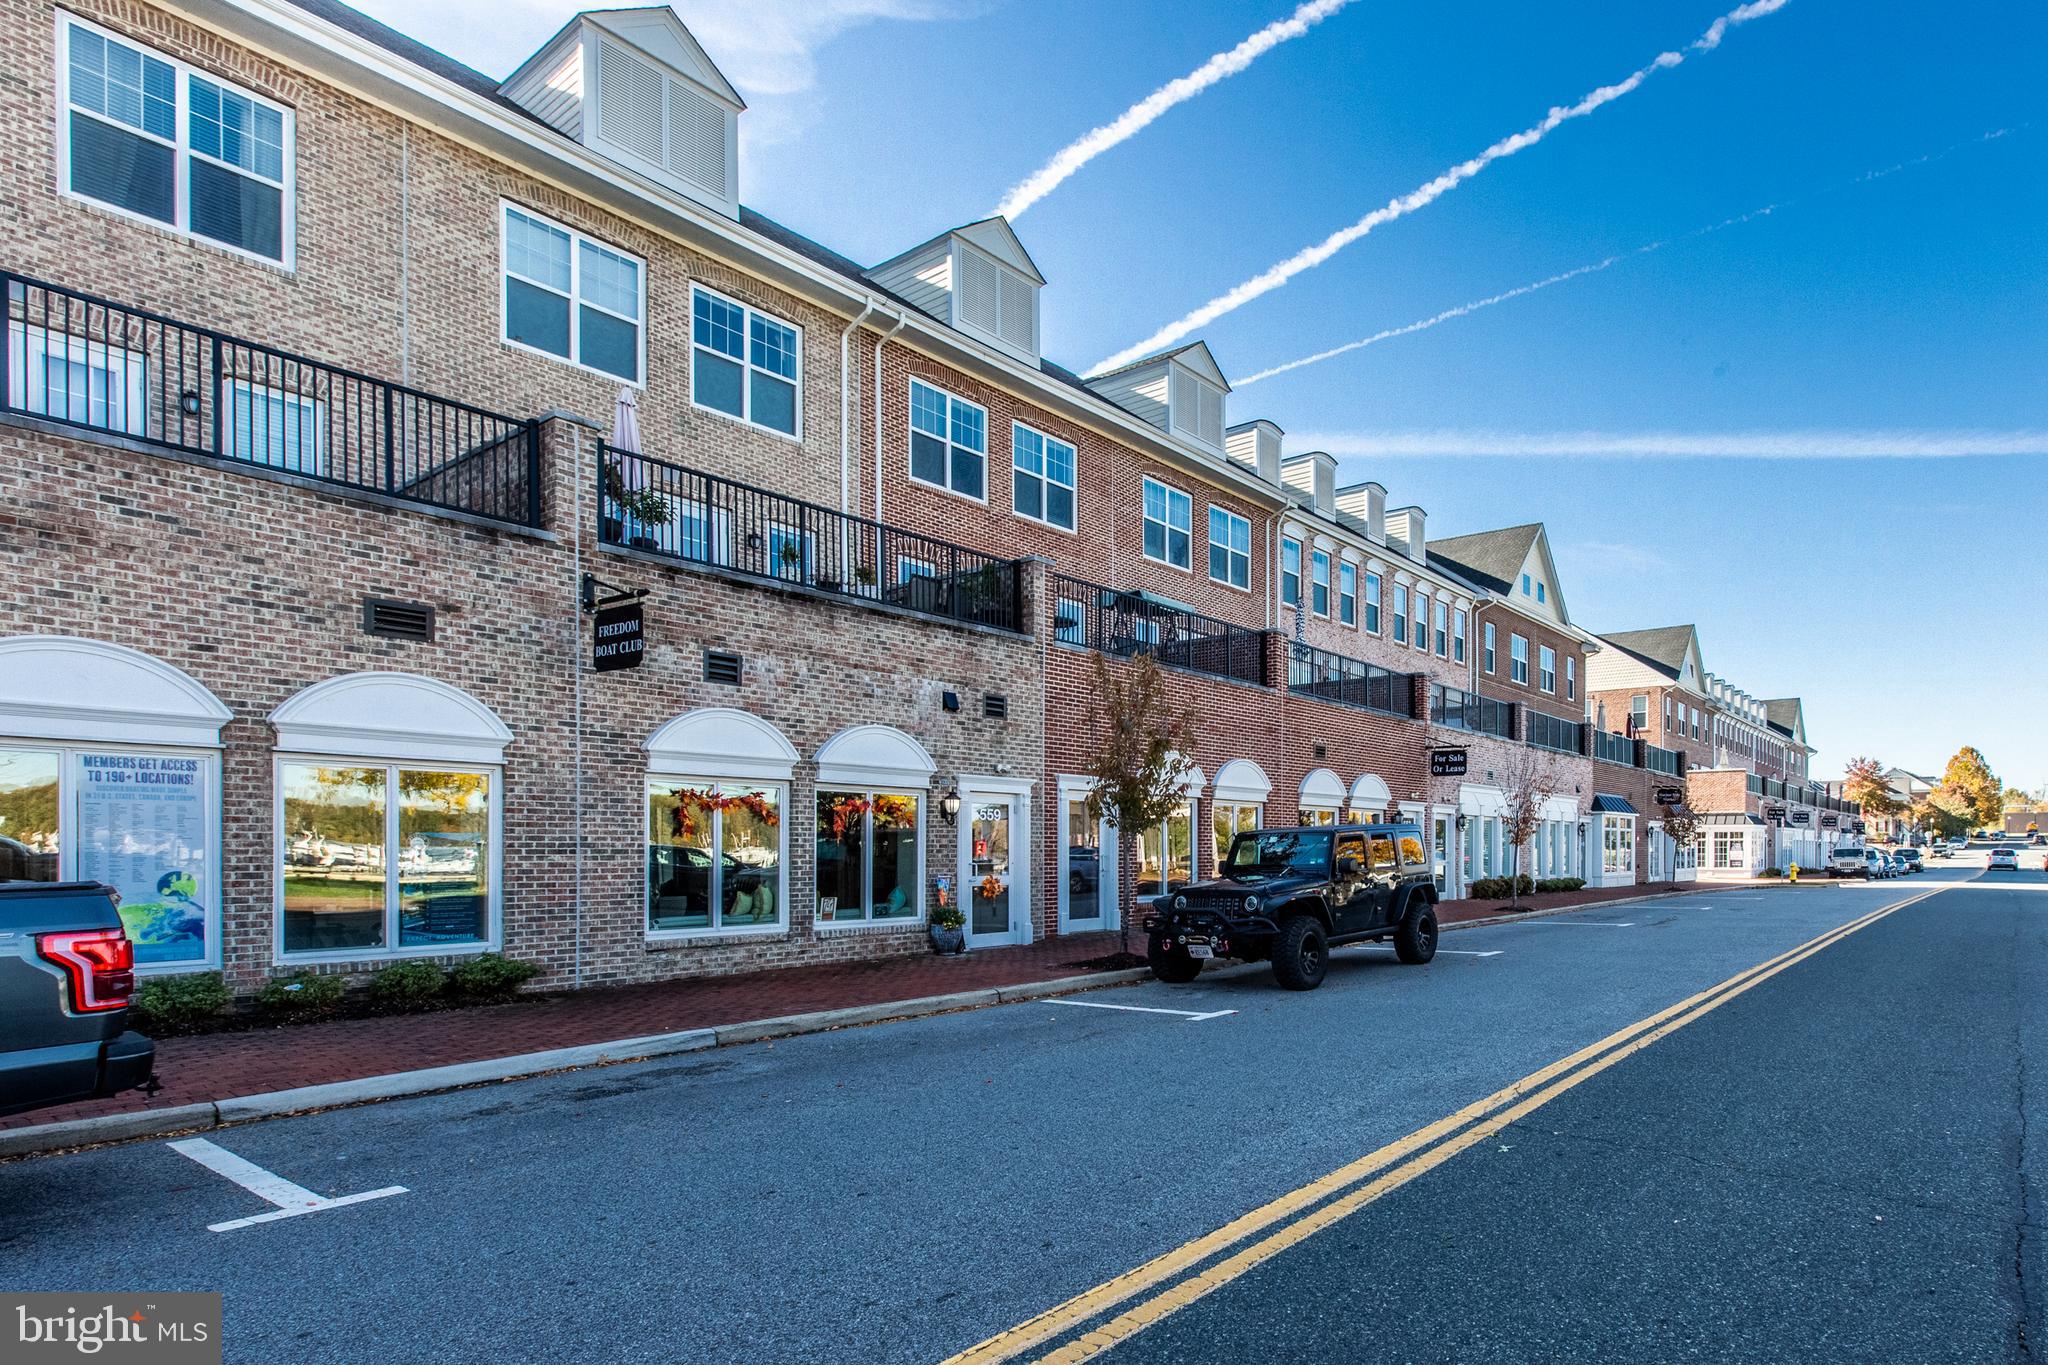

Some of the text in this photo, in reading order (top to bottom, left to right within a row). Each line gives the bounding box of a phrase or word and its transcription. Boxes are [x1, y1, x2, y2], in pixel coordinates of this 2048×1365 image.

[598, 620, 639, 637] FREEDOM
[595, 639, 643, 657] BOAT CLUB
[83, 756, 198, 772] MEMBERS GET ACCESS
[1434, 754, 1464, 762] For Sale
[1433, 765, 1443, 773] Or
[88, 770, 101, 782] TO
[135, 772, 194, 785] LOCATIONS!
